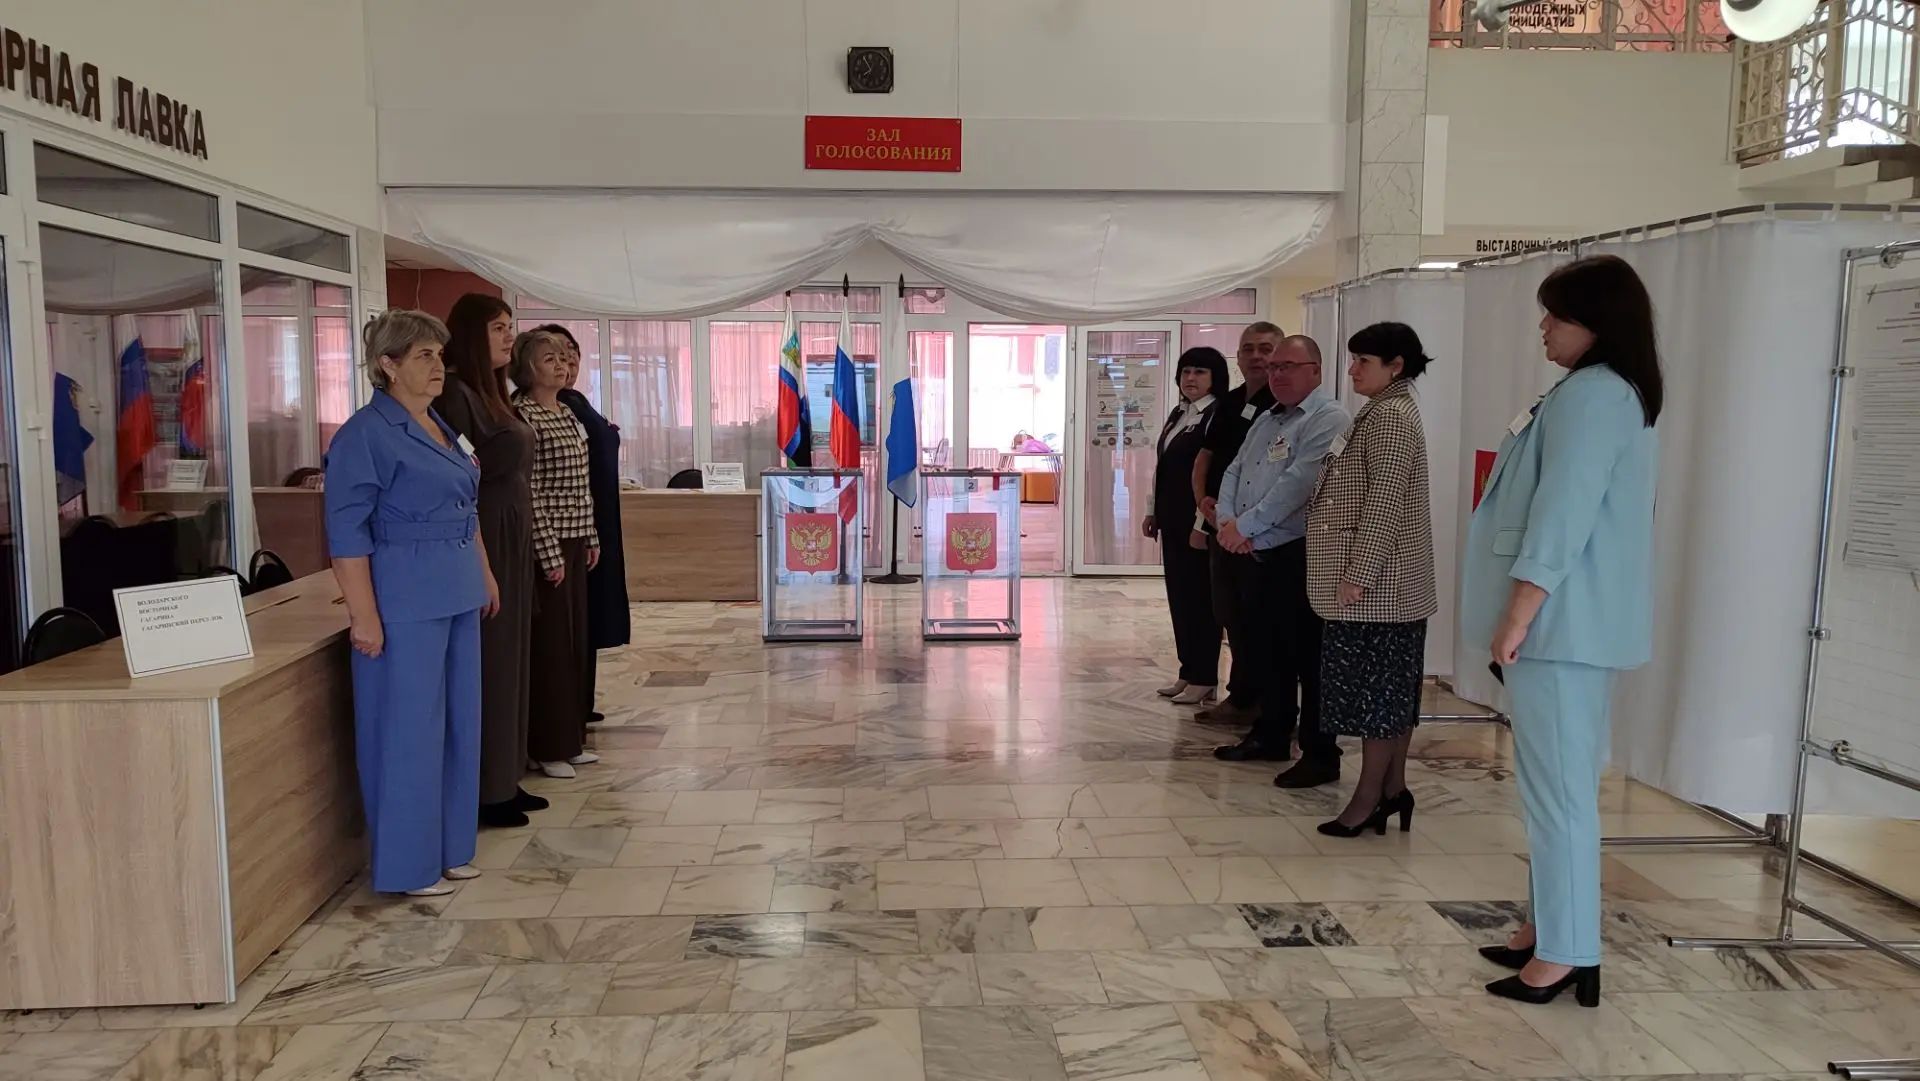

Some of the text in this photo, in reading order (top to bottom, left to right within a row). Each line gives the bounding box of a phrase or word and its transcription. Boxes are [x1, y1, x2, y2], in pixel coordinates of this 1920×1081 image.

[1509, 3, 1586, 15] ОЛОДЕЖНЫХ
[0, 25, 209, 160] РНАЯ ЛАВКА
[866, 128, 901, 142] ЗАЛ
[815, 144, 953, 161] ГОЛОСОВАНИЯ
[137, 594, 189, 606] ВОЛОДАРСКОГО
[139, 604, 179, 614] ВОСТОЧНАЯ
[140, 614, 174, 623] ГАГАРИНА
[142, 619, 189, 632] ГАГАРИНСКИЙ
